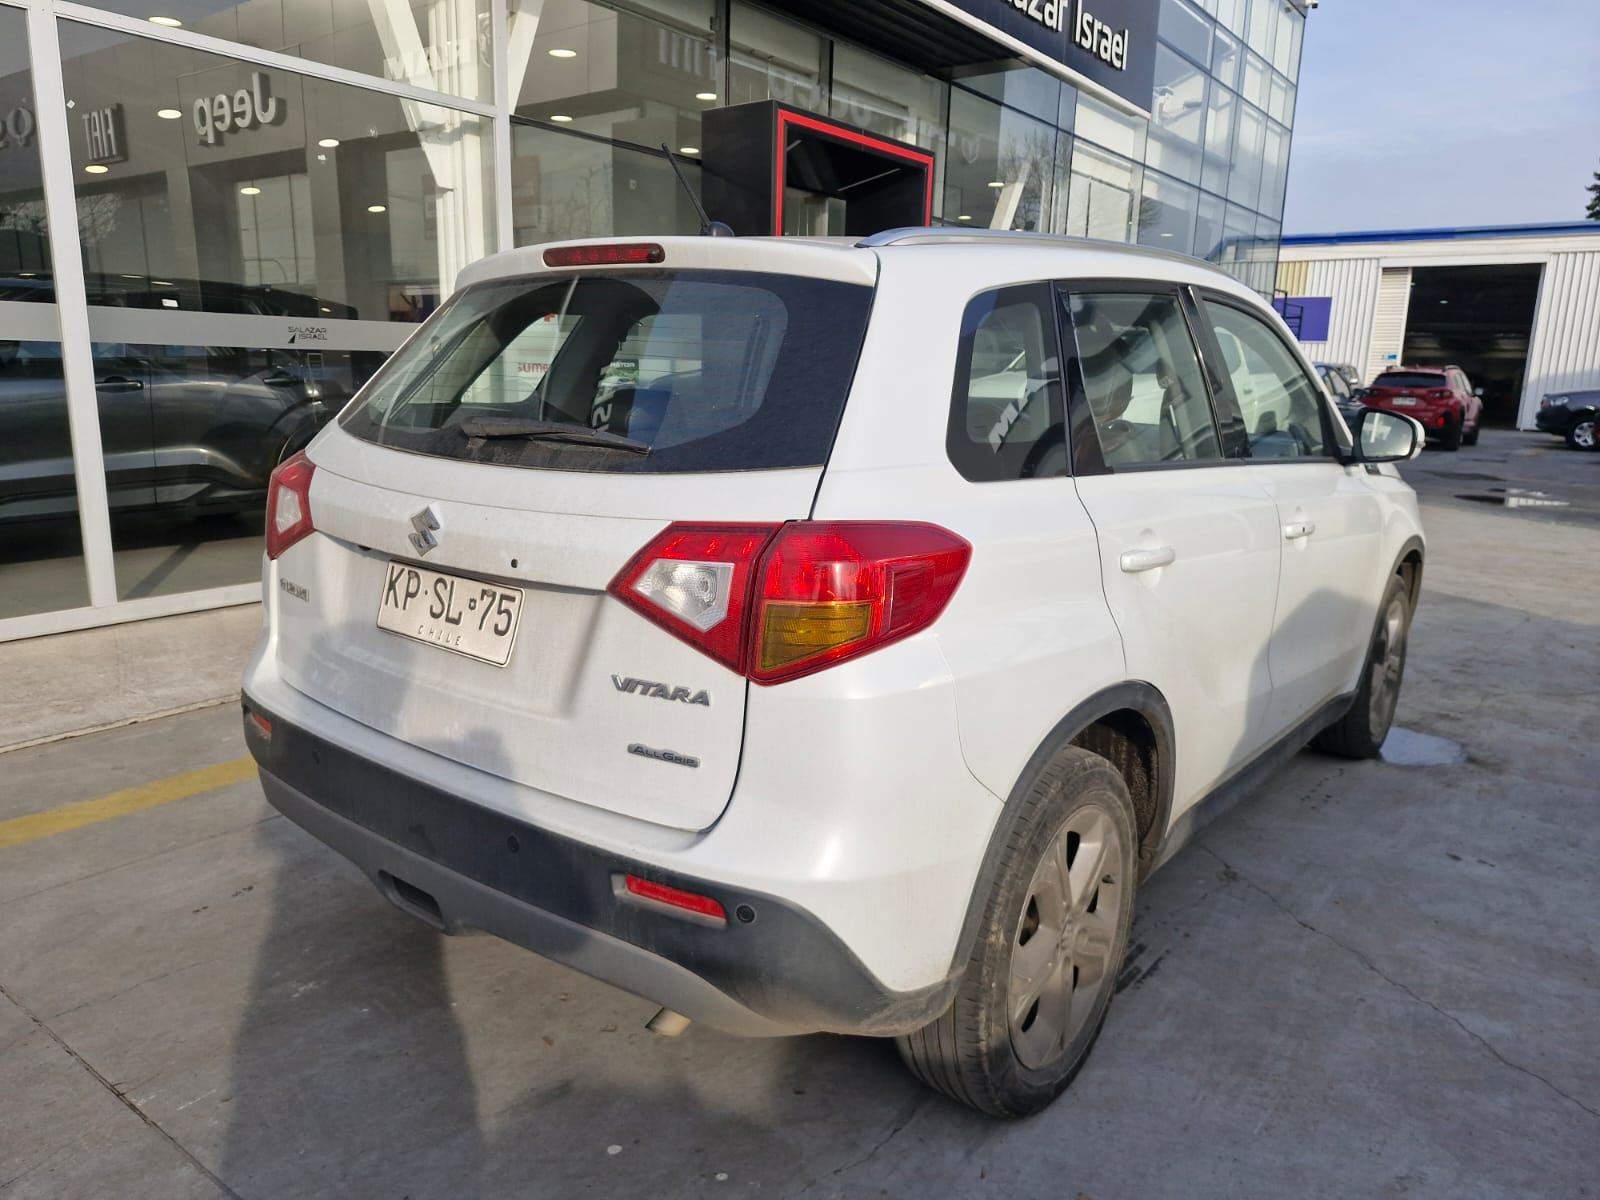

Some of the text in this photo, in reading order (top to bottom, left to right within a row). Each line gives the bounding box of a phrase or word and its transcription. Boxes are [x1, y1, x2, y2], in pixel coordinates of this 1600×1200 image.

[1075, 0, 1129, 71] Israel
[417, 624, 464, 646] CHILE
[610, 673, 710, 707] VITARA
